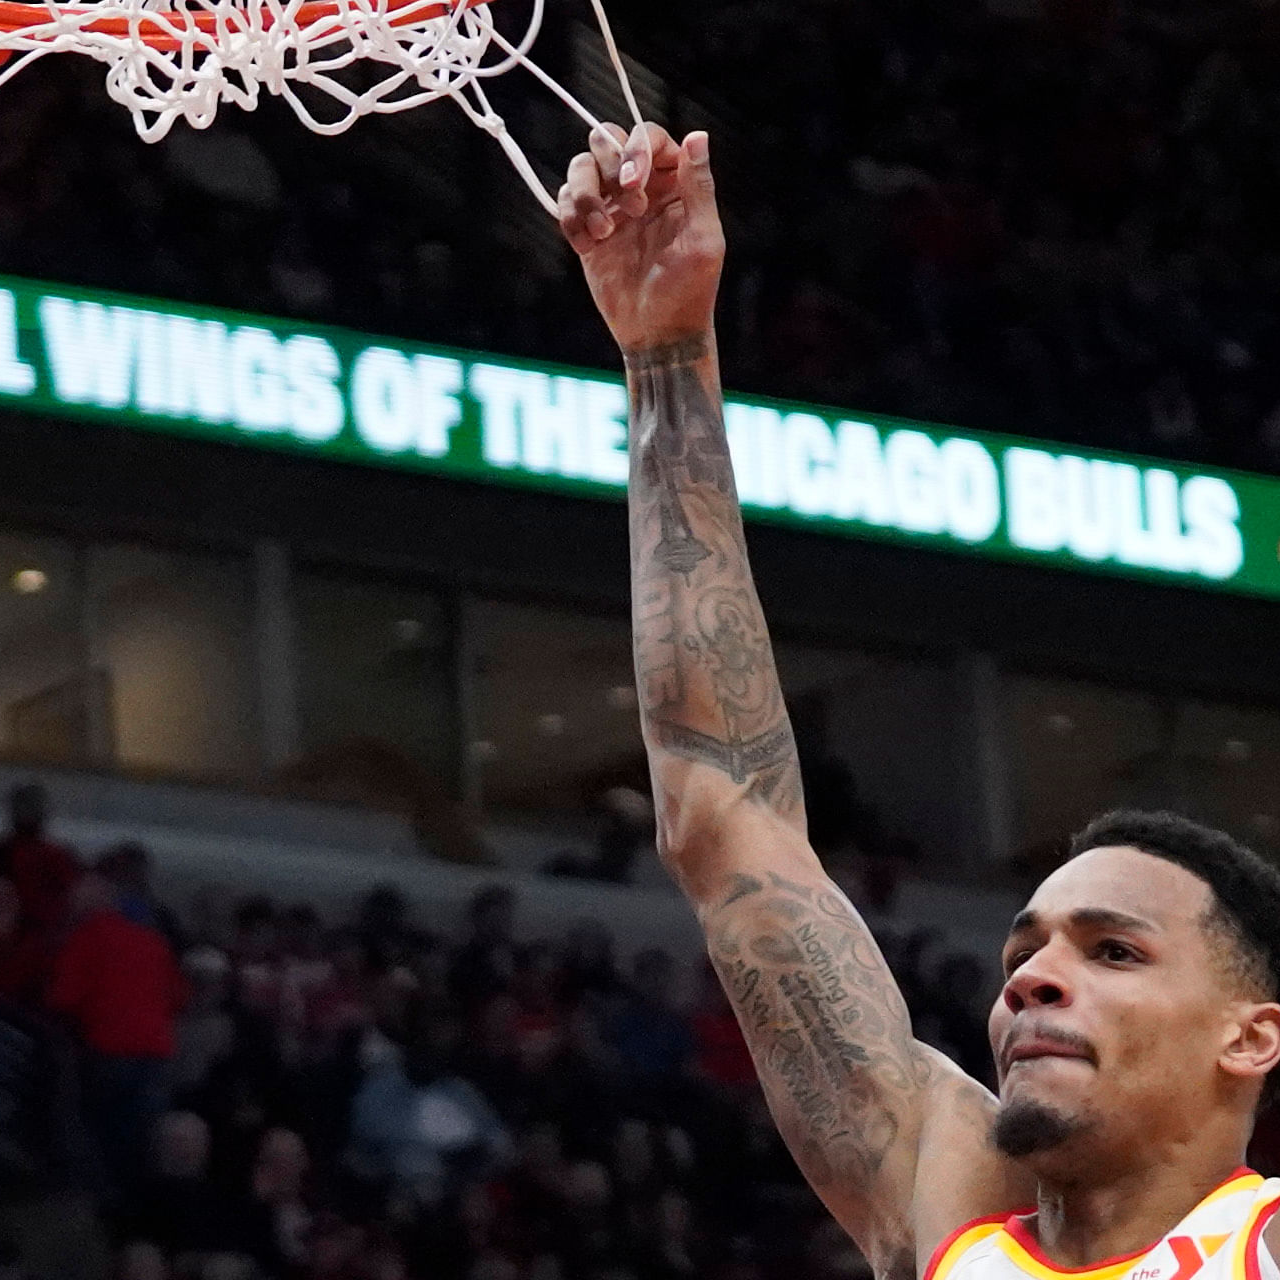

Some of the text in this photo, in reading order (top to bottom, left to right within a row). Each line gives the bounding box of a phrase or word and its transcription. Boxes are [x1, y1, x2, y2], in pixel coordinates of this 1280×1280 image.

[38, 296, 345, 441] WINGS
[350, 345, 463, 459] OF
[469, 362, 629, 486] THE
[723, 402, 1001, 543] ICAGO
[1004, 446, 1243, 581] BULLS
